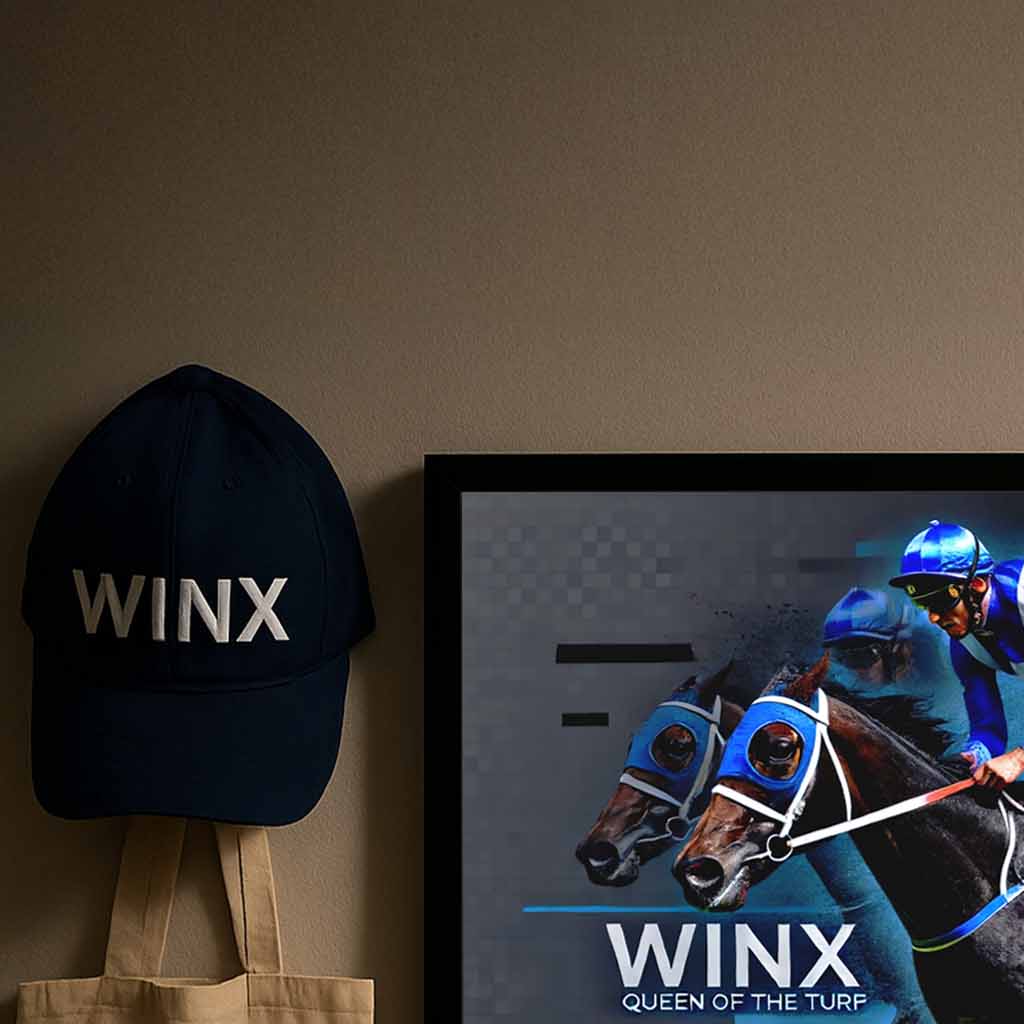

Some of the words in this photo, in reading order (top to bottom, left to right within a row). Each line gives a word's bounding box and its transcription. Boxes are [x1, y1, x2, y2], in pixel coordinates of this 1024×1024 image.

[72, 568, 290, 643] WINX
[605, 923, 860, 988] WINX
[622, 993, 704, 1012] QUEEN
[712, 993, 744, 1010] OF
[751, 993, 797, 1010] THE
[804, 993, 867, 1010] TURF
